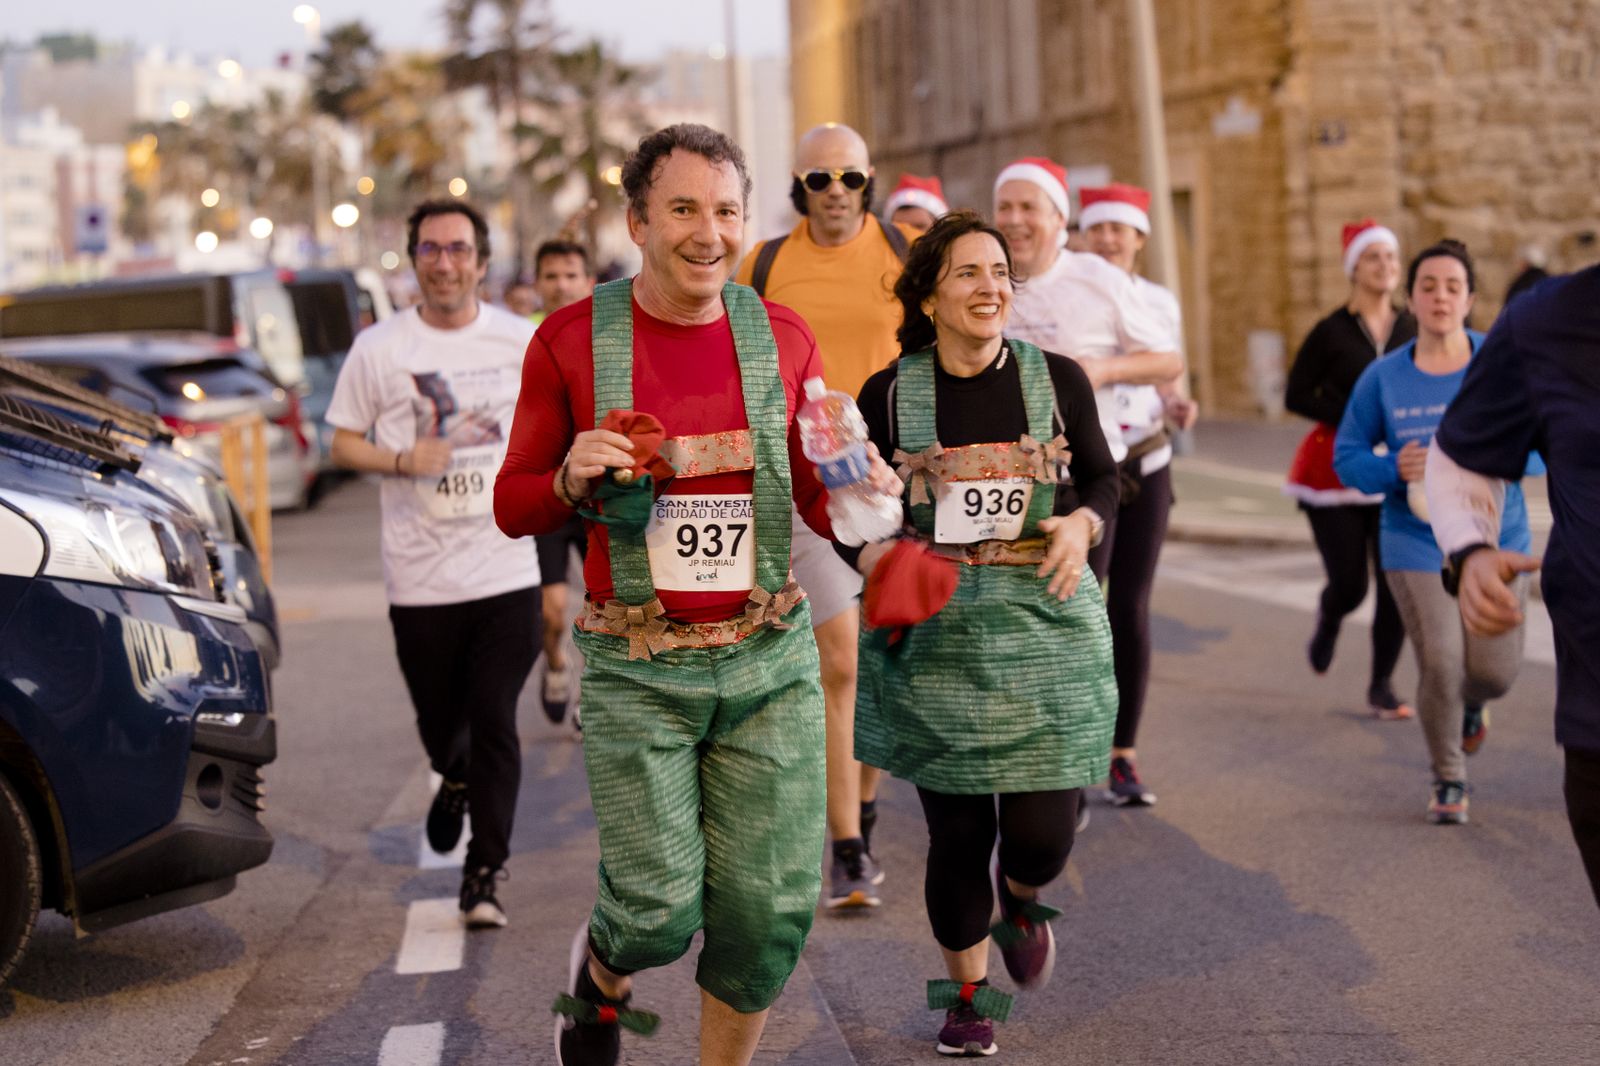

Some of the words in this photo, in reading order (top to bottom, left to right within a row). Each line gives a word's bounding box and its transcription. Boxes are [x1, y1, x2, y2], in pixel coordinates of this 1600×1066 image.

[437, 472, 484, 497] 489
[656, 500, 687, 508] SAN
[964, 488, 1026, 517] 936
[656, 508, 707, 518] CIUDAD
[711, 508, 728, 518] DE
[731, 507, 755, 518] CAD
[677, 524, 747, 557] 937
[688, 559, 700, 567] JP
[702, 559, 735, 567] REMIAU
